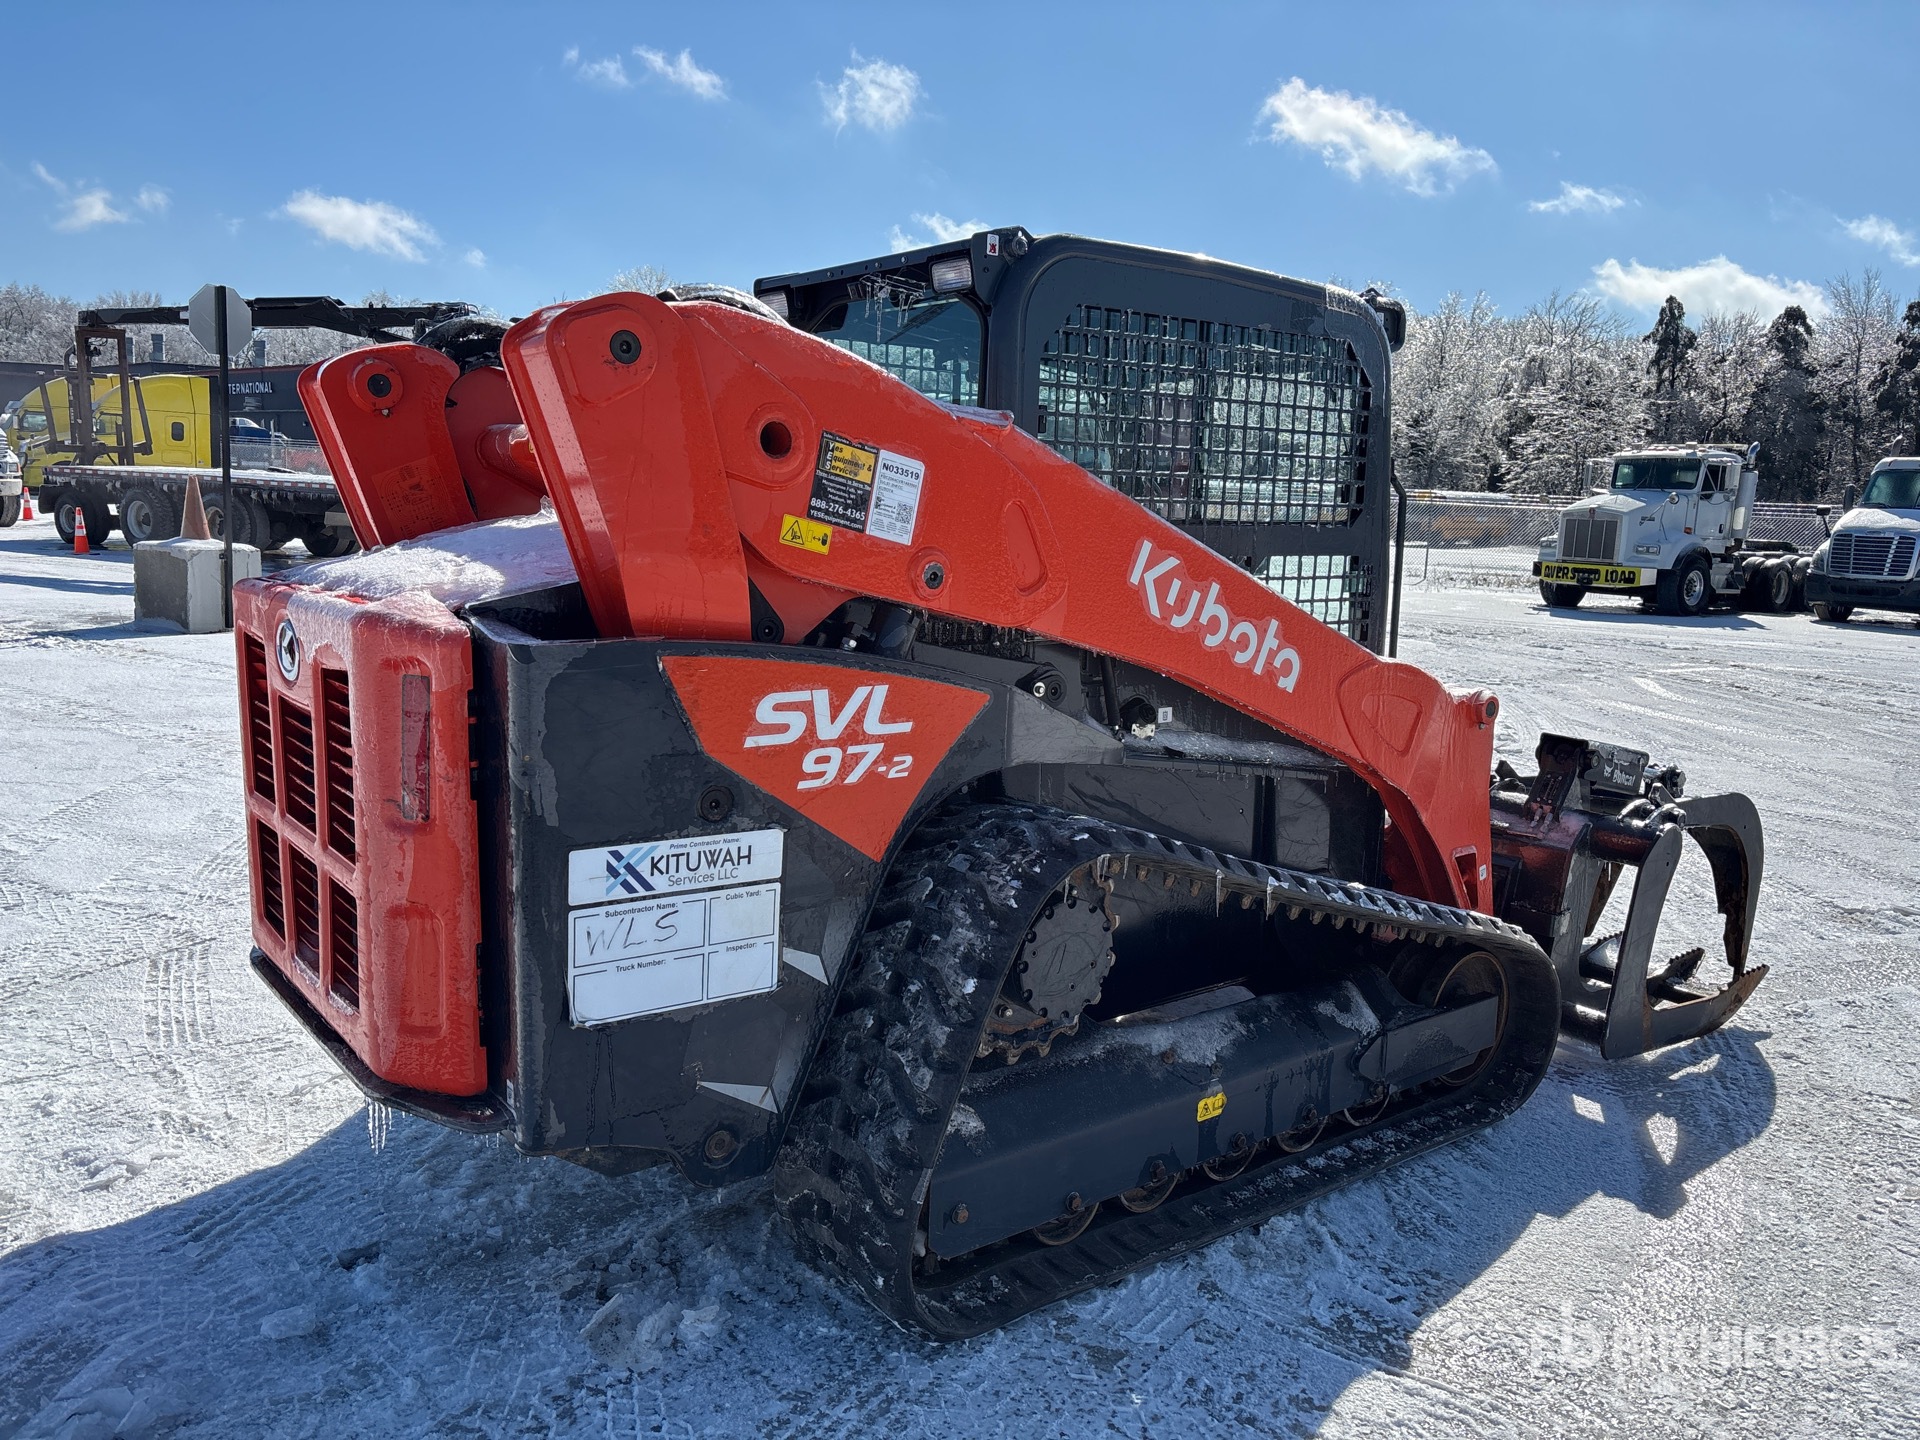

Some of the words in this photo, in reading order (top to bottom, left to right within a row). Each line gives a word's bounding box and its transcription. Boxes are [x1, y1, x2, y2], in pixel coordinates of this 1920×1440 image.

[228, 382, 272, 394] TERNATIONAL
[827, 451, 865, 470] Equipment
[882, 462, 920, 480] N033519
[810, 497, 865, 520] 888-276-4365
[810, 509, 863, 529] YESEquipment.com
[1130, 539, 1300, 694] Kubota
[744, 684, 913, 748] SVL
[796, 742, 913, 790] 97-2
[669, 842, 688, 850] Prime
[689, 840, 721, 848] Contractor
[650, 845, 752, 877] KITUWAH
[668, 873, 715, 887] Services
[718, 867, 739, 880] LLC
[726, 892, 744, 900] Cubic
[605, 905, 654, 918] Subcontractor
[656, 902, 678, 910] Name:
[726, 942, 757, 952] Inspector:
[616, 964, 635, 972] Truck
[637, 959, 666, 969] Number:
